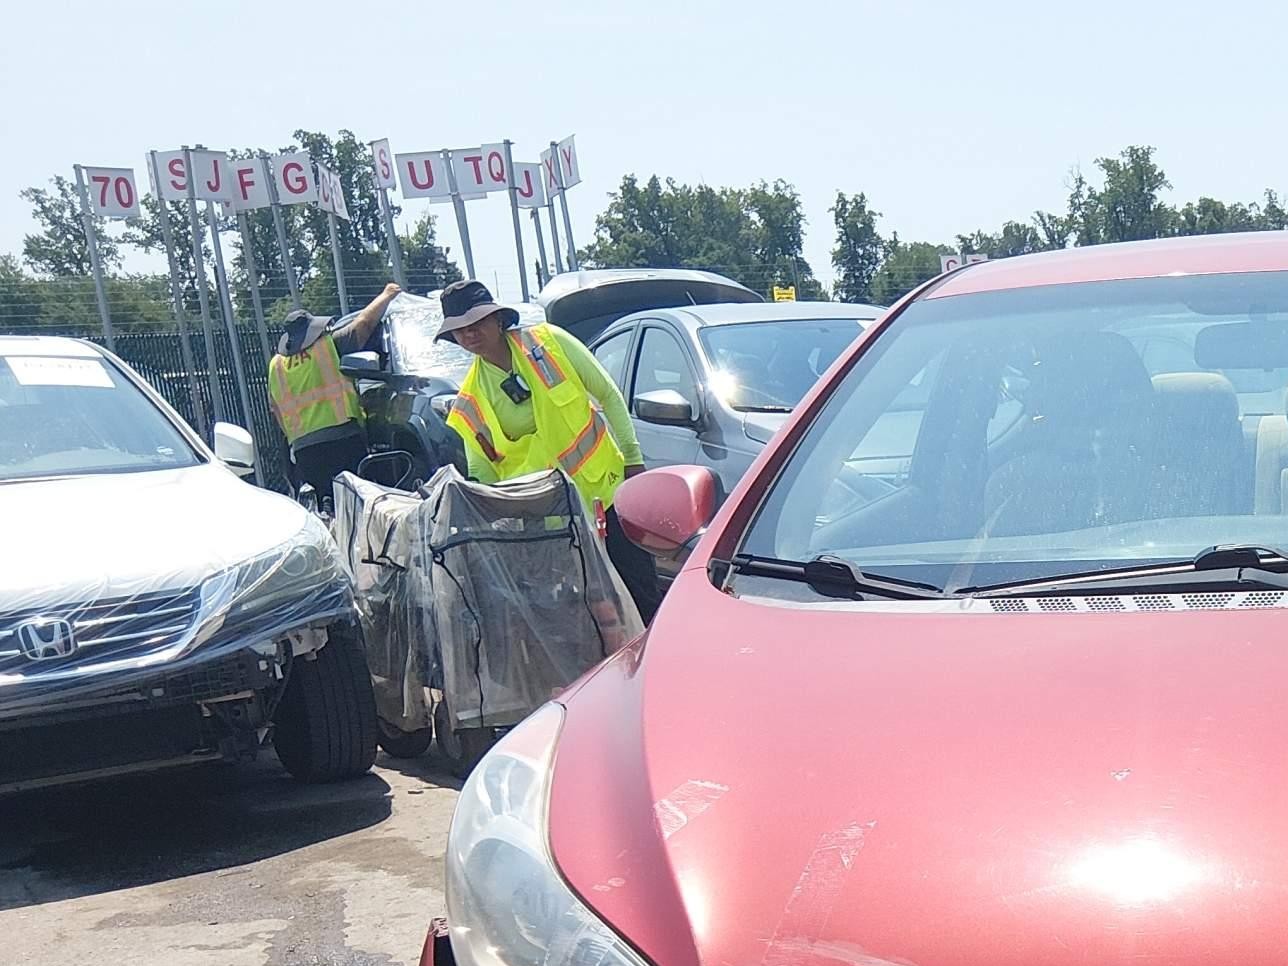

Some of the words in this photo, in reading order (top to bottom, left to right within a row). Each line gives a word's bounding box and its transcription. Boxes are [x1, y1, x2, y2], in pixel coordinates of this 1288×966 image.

[168, 159, 187, 191] S
[206, 160, 220, 192] J
[379, 149, 390, 180] S
[407, 160, 434, 190] U
[463, 156, 482, 184] T
[487, 152, 506, 183] Q
[562, 147, 572, 177] Y
[92, 175, 134, 208] 70
[237, 168, 255, 200] F
[282, 163, 309, 194] G
[518, 170, 533, 198] J
